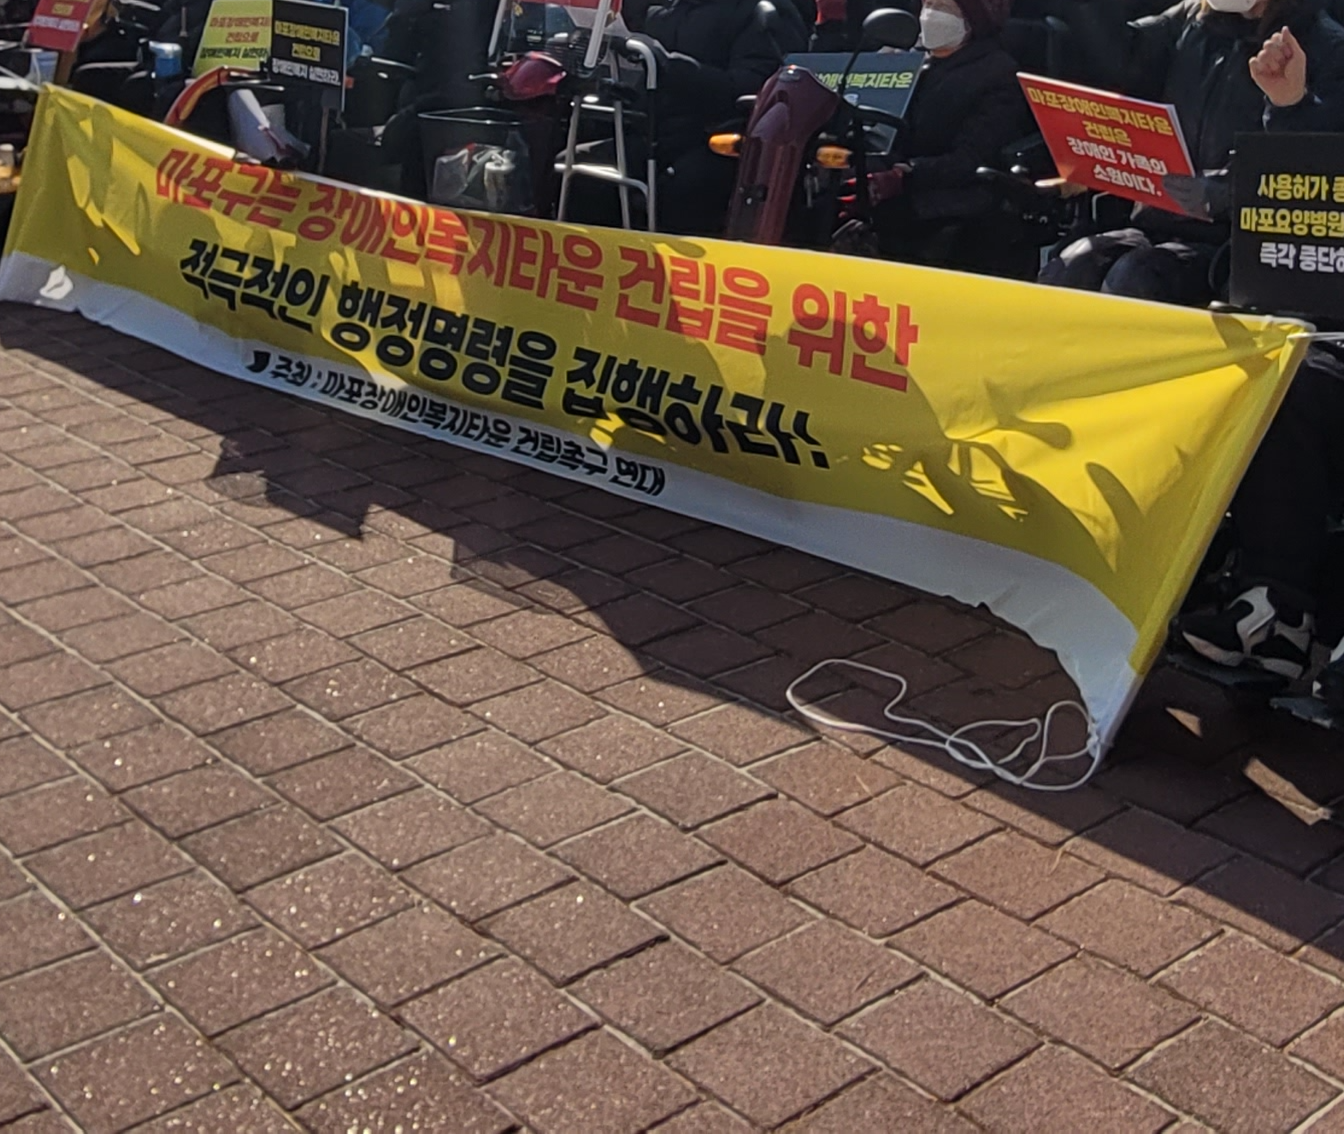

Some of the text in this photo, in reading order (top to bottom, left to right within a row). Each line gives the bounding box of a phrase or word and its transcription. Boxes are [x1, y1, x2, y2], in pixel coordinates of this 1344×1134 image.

[1026, 86, 1174, 137] 마포장애인복지타운
[1082, 120, 1133, 148] 건립은
[1066, 136, 1169, 176] 장애인 가족의
[1093, 163, 1164, 197] 소원이다.
[1257, 174, 1330, 202] 사용허가
[156, 147, 919, 393] 마포구는 장애인복지타운 건립을 위한
[1259, 241, 1297, 269] 즉각
[179, 237, 831, 470] 적극적인 행정명령을 집행하라!
[318, 369, 513, 449] 마포장애인복지타운
[510, 425, 609, 476] 건립촉구
[608, 455, 666, 497] 연대
